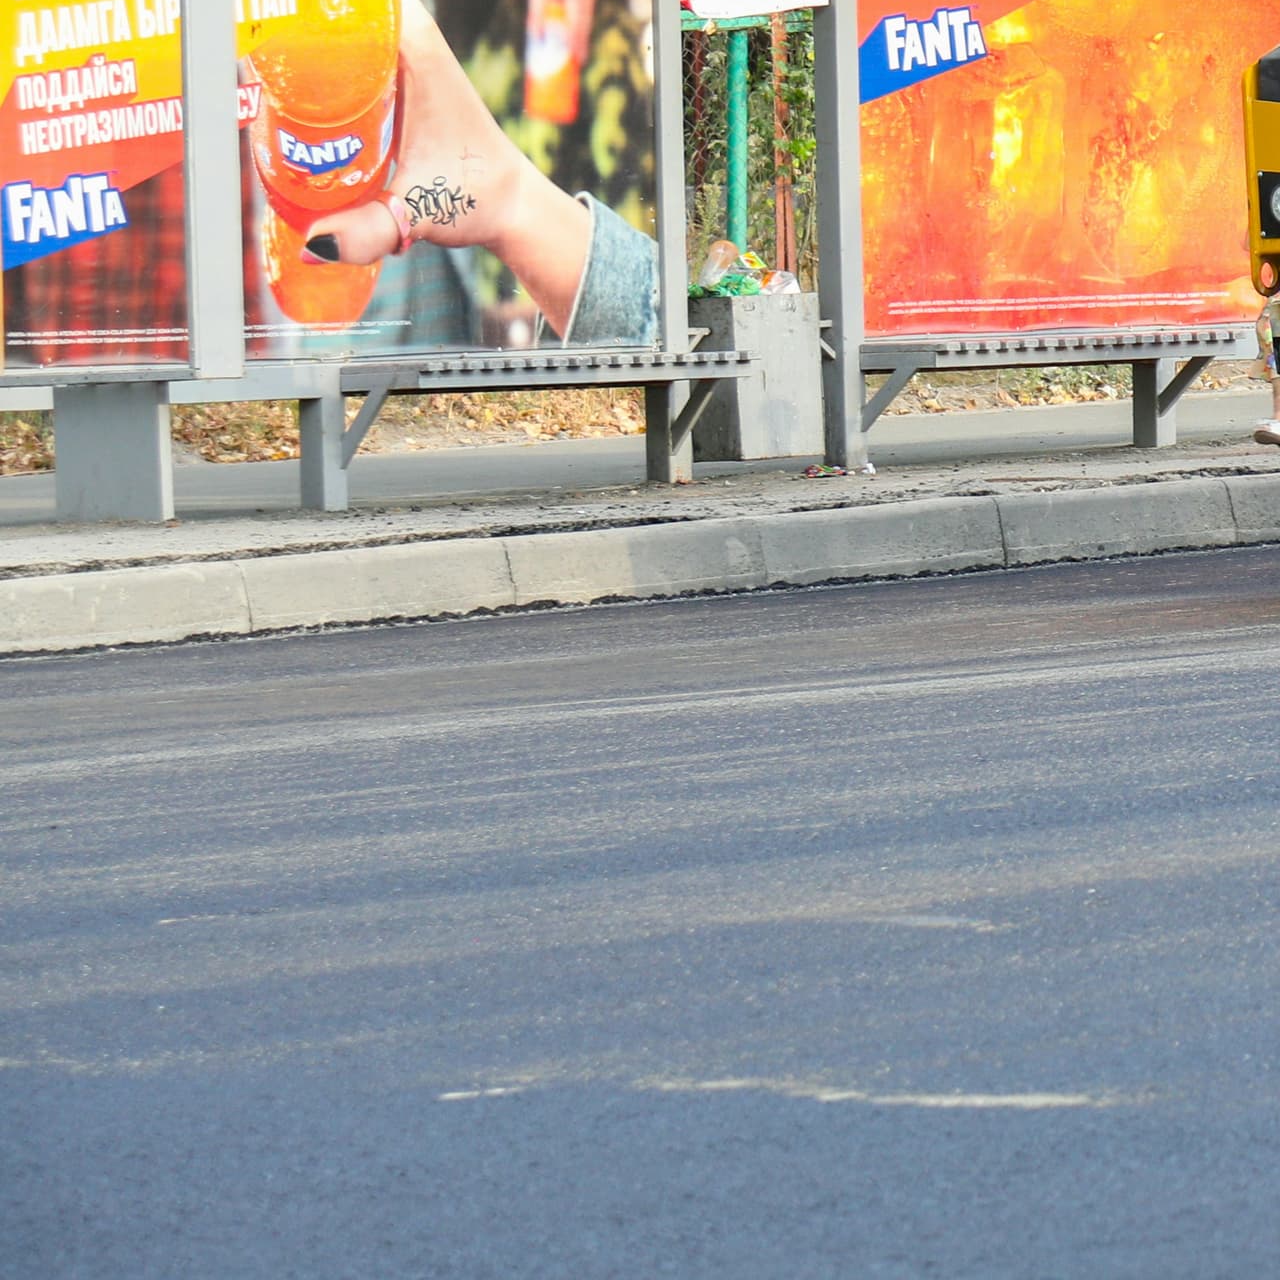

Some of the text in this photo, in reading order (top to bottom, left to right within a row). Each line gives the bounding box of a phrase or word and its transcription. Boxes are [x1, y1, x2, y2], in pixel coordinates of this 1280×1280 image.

[885, 9, 986, 71] FANTA
[17, 54, 138, 113] ПОДДАЙСЯ
[278, 129, 364, 166] FANTA
[5, 173, 127, 243] FANTA
